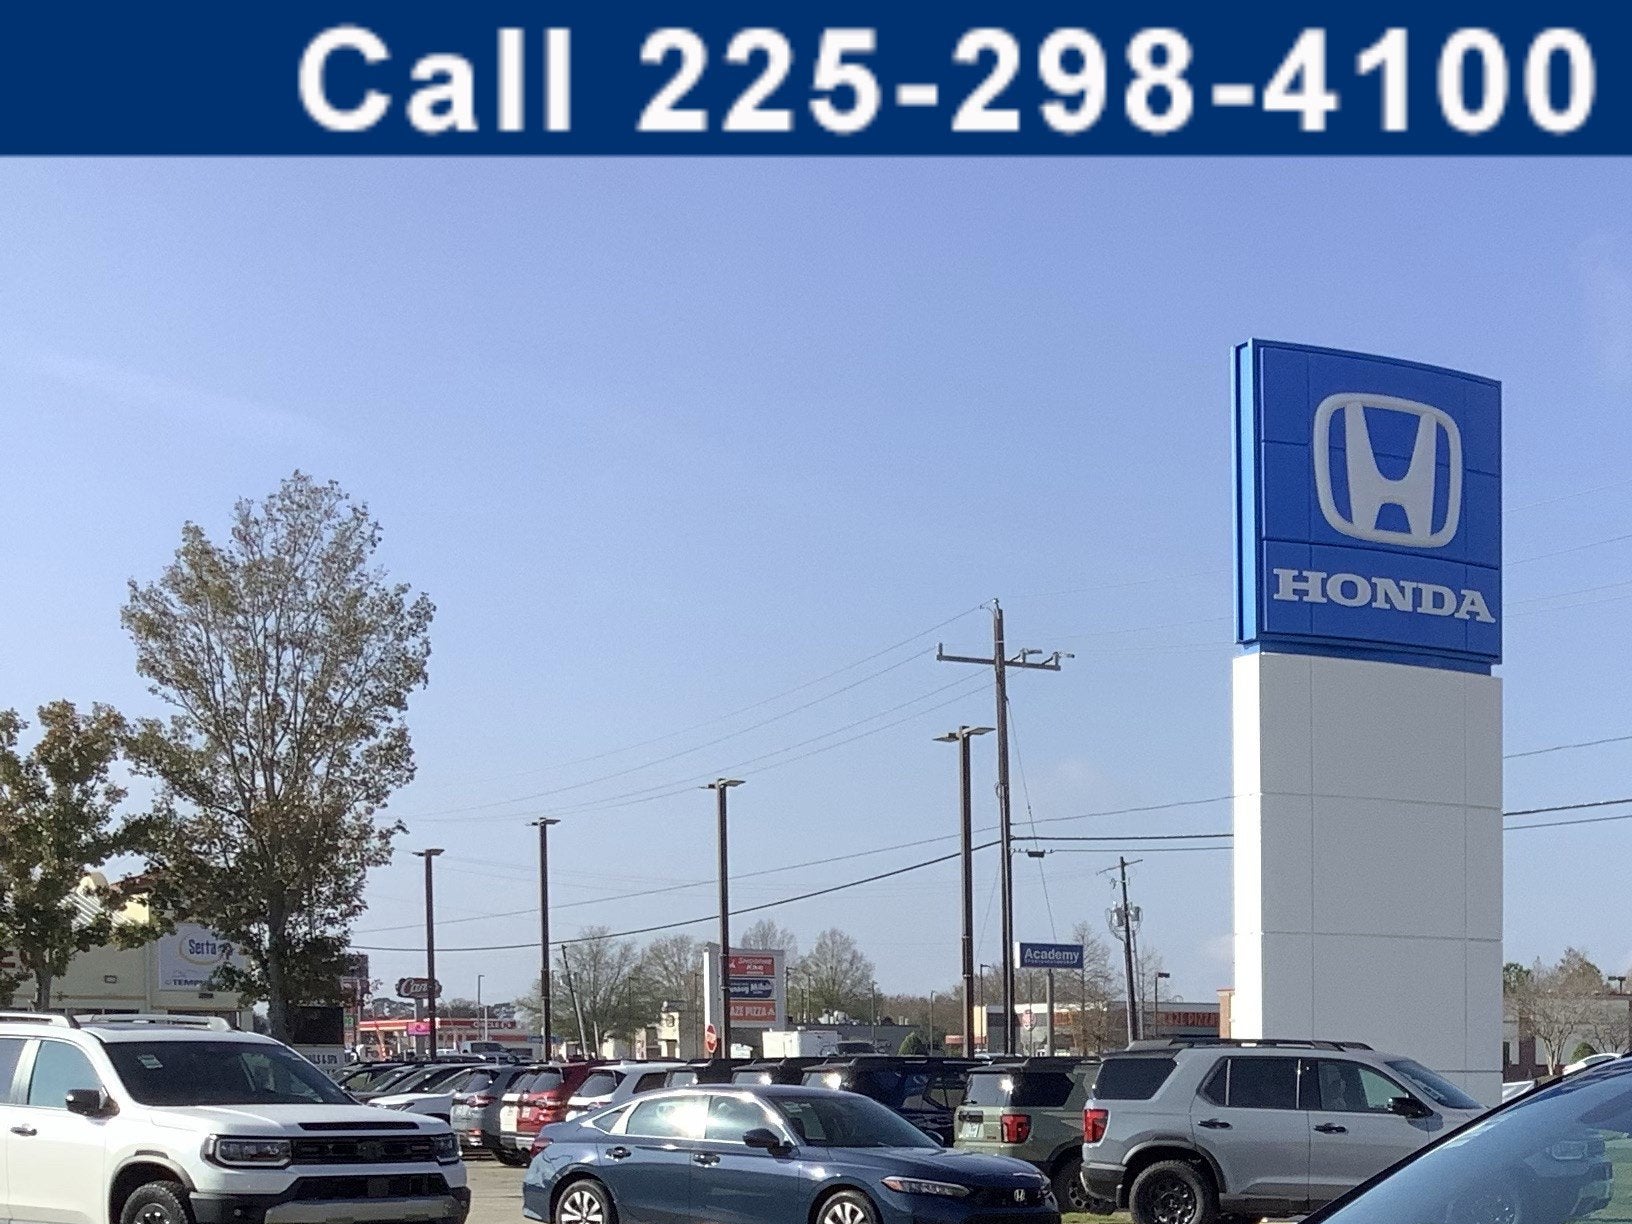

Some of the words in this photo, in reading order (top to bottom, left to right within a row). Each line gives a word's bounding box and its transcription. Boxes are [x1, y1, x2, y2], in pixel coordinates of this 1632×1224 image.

[1273, 567, 1496, 624] HONDA
[188, 939, 217, 955] Serta
[1024, 948, 1079, 963] Academy
